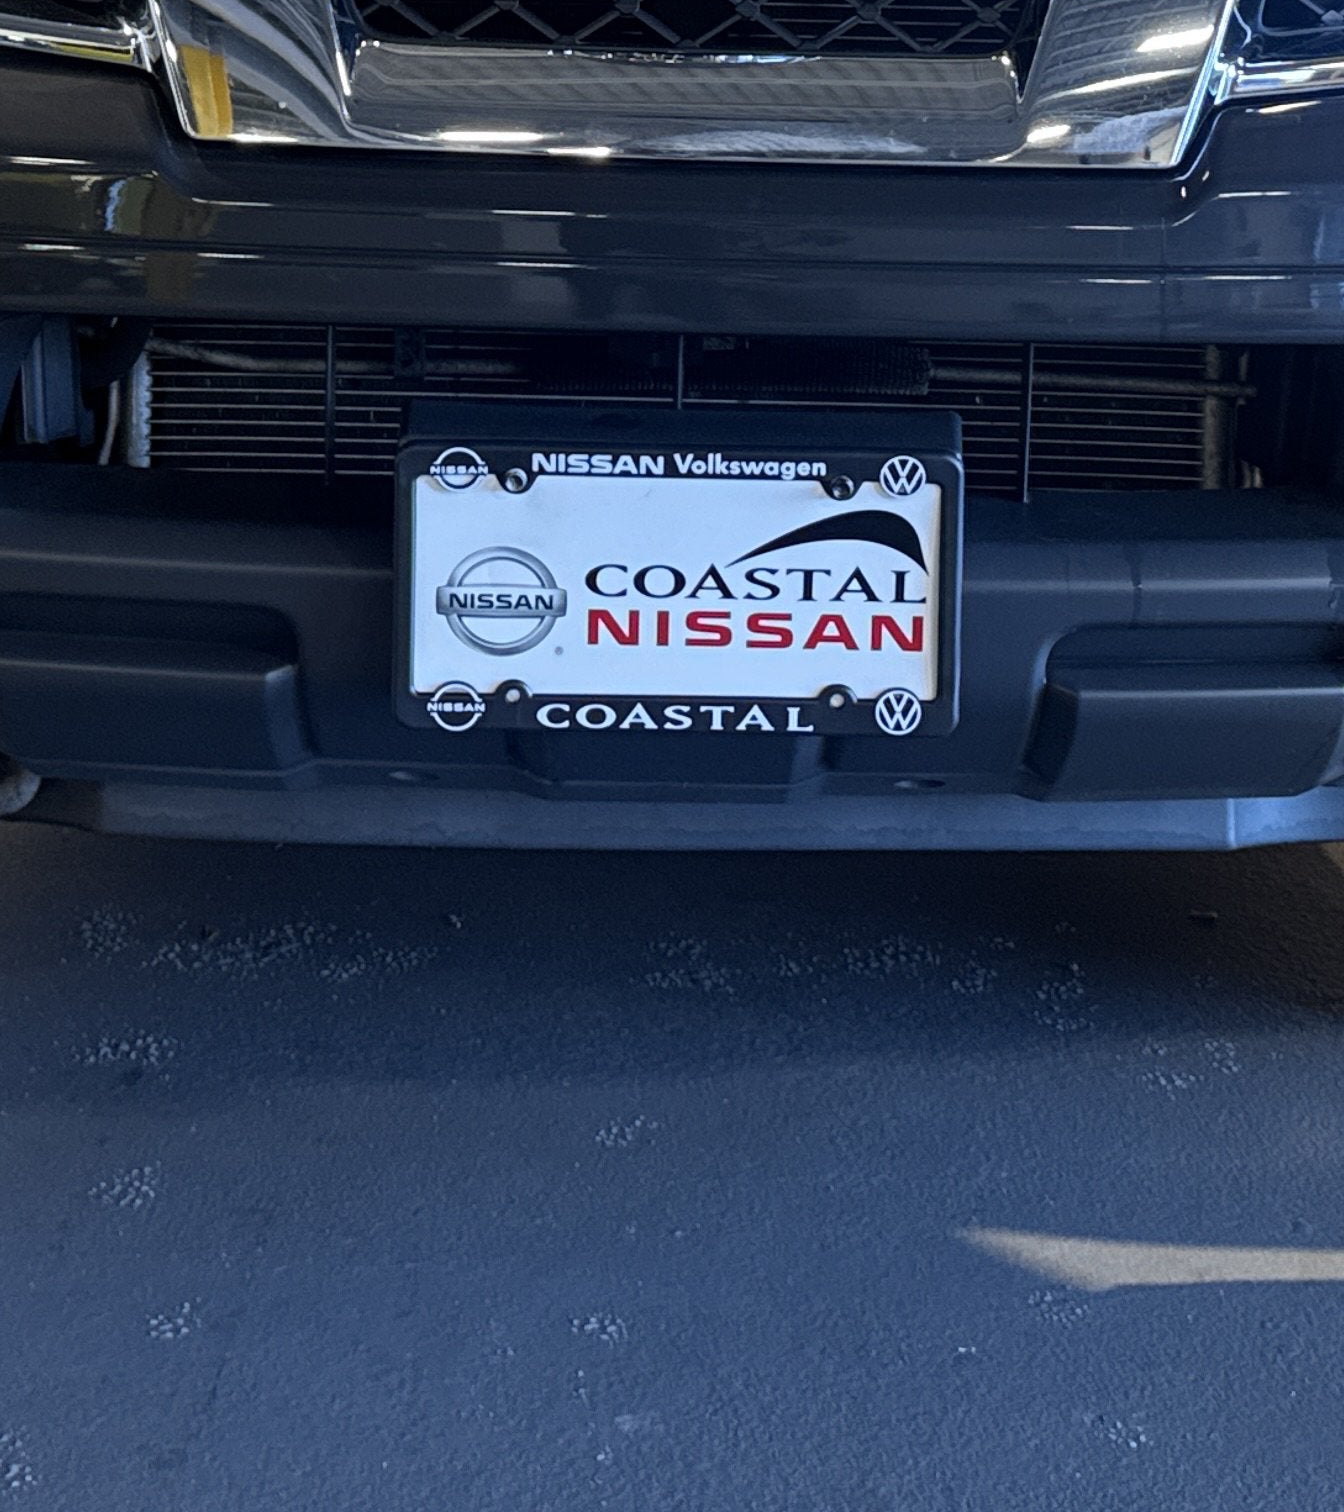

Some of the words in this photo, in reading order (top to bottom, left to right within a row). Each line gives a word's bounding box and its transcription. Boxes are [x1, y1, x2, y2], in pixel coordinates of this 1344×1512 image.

[430, 465, 489, 475] NISSAN
[532, 453, 665, 475] NISSAN
[673, 453, 827, 480] Volkswagen
[585, 563, 927, 604] COASTAL
[449, 593, 554, 610] NISSAN
[587, 609, 924, 652] NISSAN
[426, 702, 486, 712] NISSAN
[536, 702, 814, 732] COASTAL
